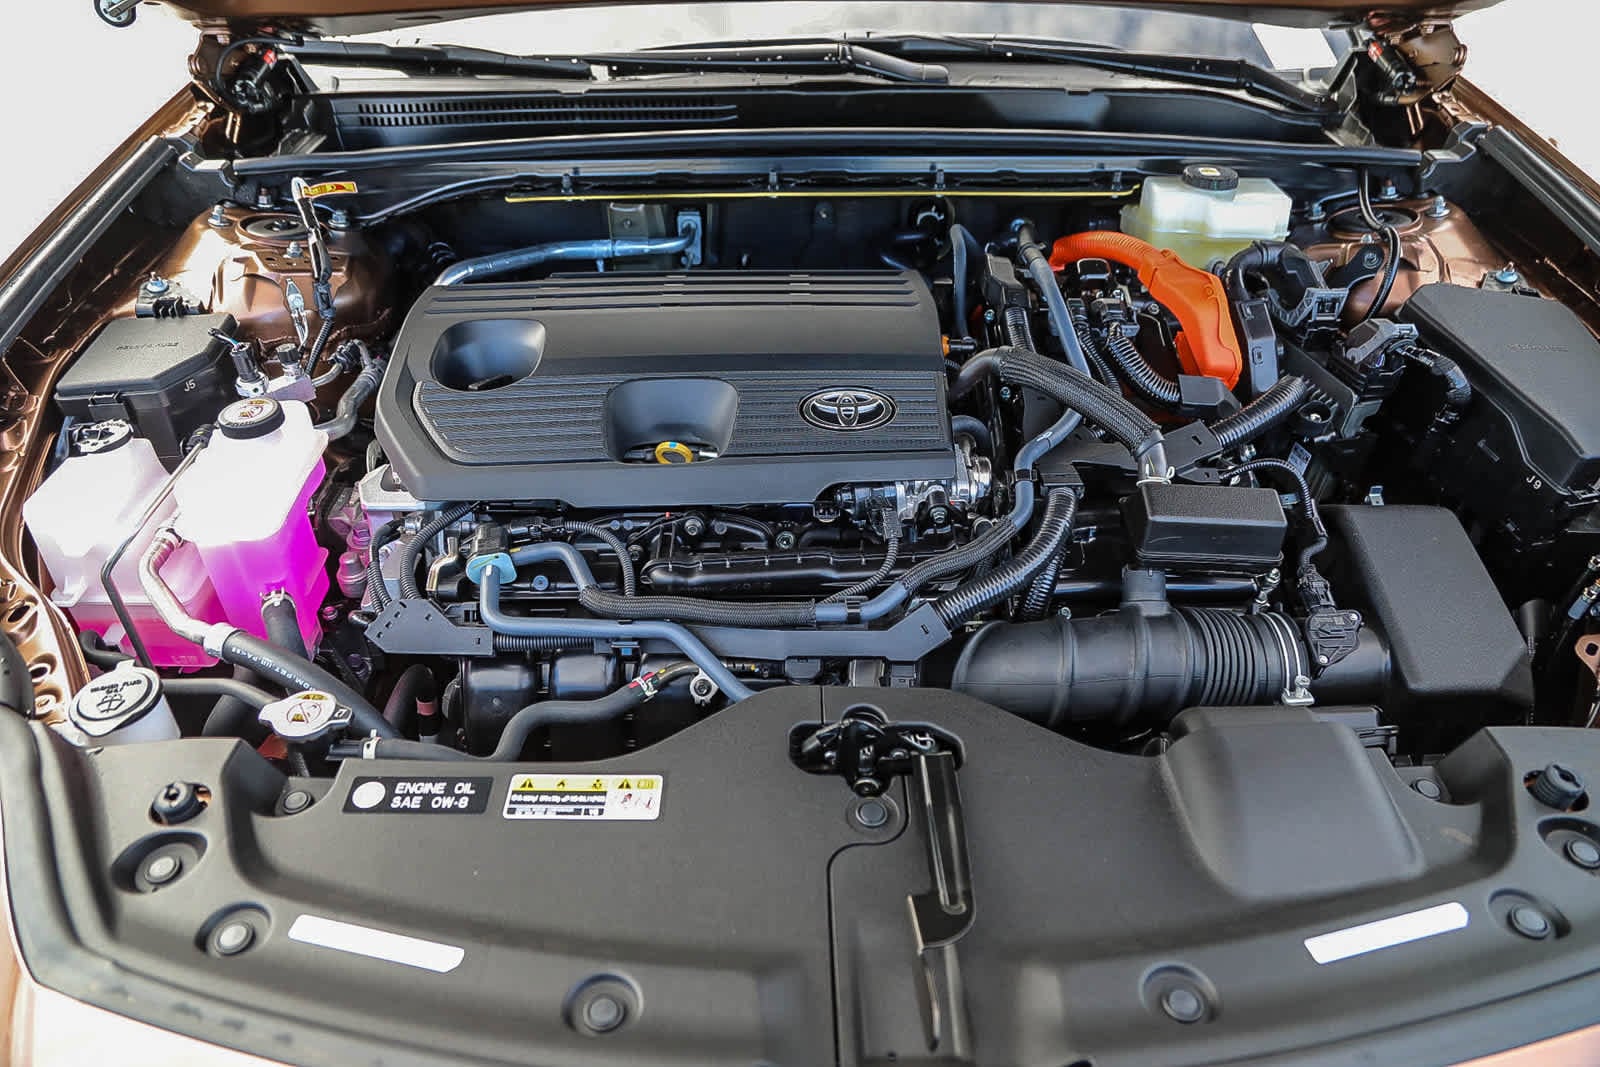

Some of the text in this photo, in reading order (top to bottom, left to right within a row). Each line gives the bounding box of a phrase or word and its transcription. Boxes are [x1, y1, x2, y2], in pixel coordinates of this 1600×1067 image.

[184, 379, 196, 392] J5
[1526, 475, 1542, 490] J9
[394, 782, 476, 794] ENGINE OIL
[390, 796, 423, 808] SAE
